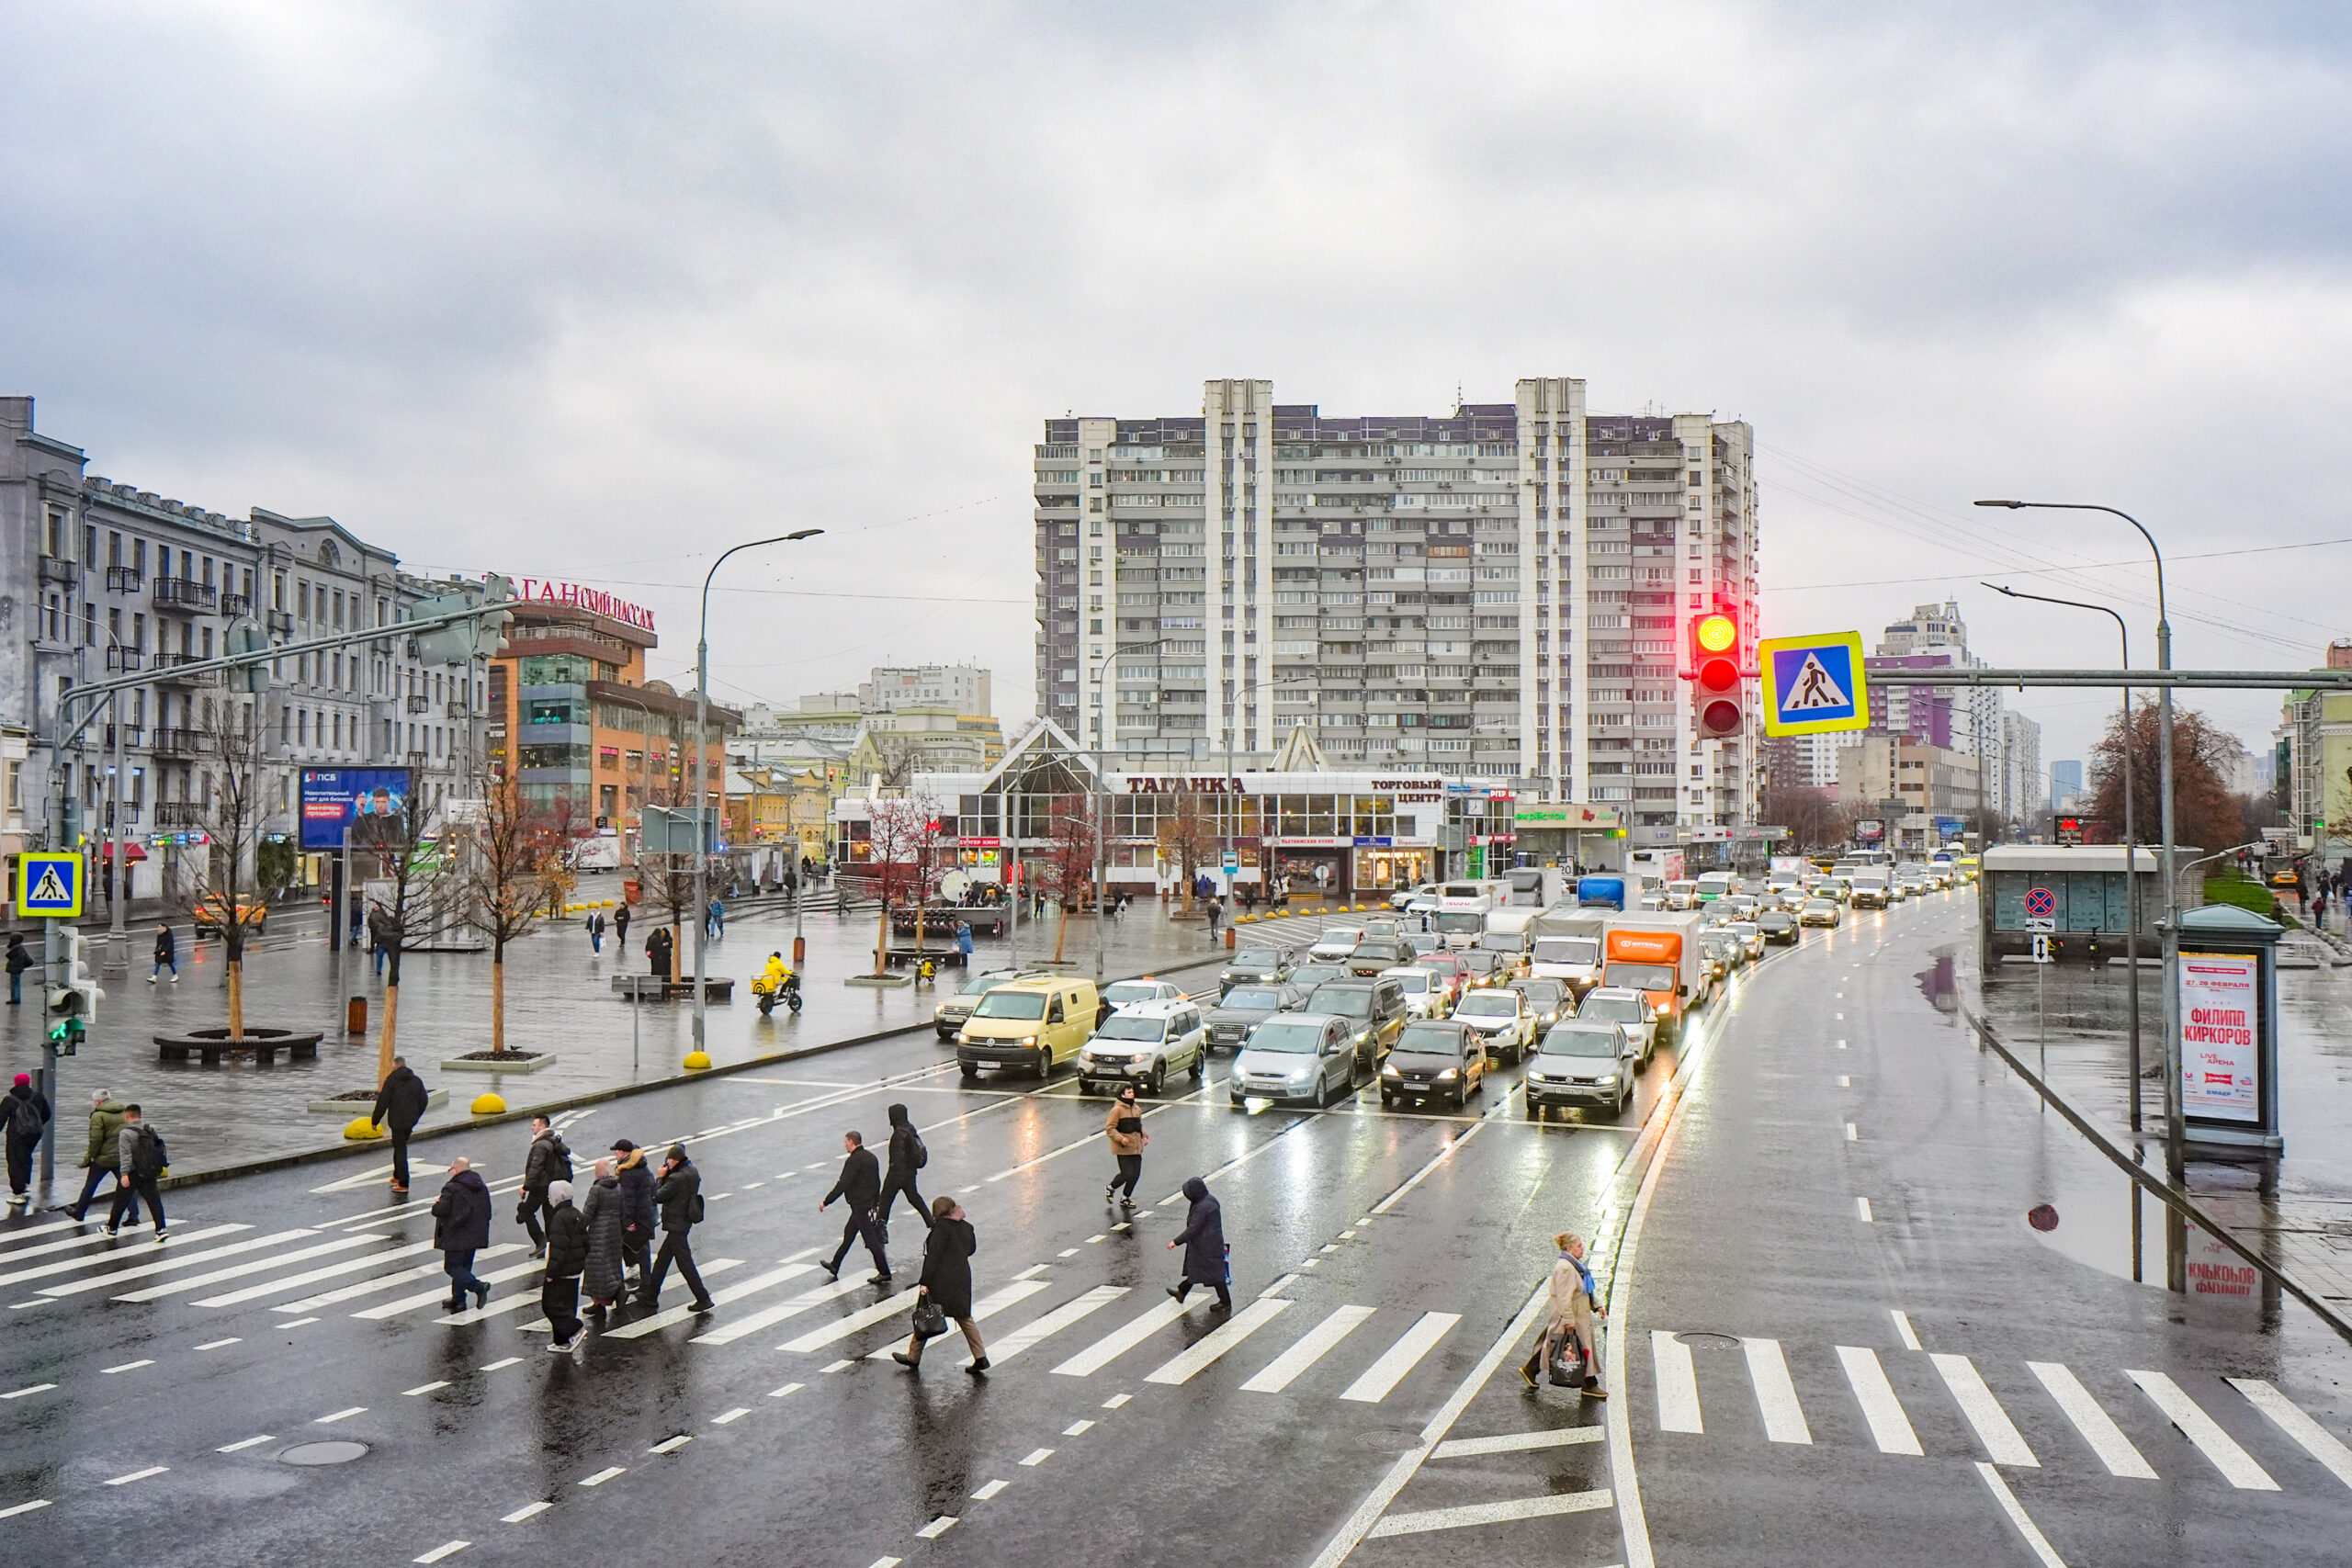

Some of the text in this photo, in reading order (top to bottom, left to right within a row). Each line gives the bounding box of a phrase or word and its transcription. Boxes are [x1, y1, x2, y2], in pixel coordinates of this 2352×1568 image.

[613, 597, 654, 631] ПАССАЖ
[317, 773, 336, 782] ПСБ
[1126, 777, 1246, 794] ТАГАНКА
[1372, 779, 1442, 790] ТОРГОВЫЙ
[1398, 794, 1442, 804] ЦЕНТР
[2191, 1007, 2245, 1027] ФИЛИПП
[2184, 1025, 2251, 1045] КИРКОРОВ
